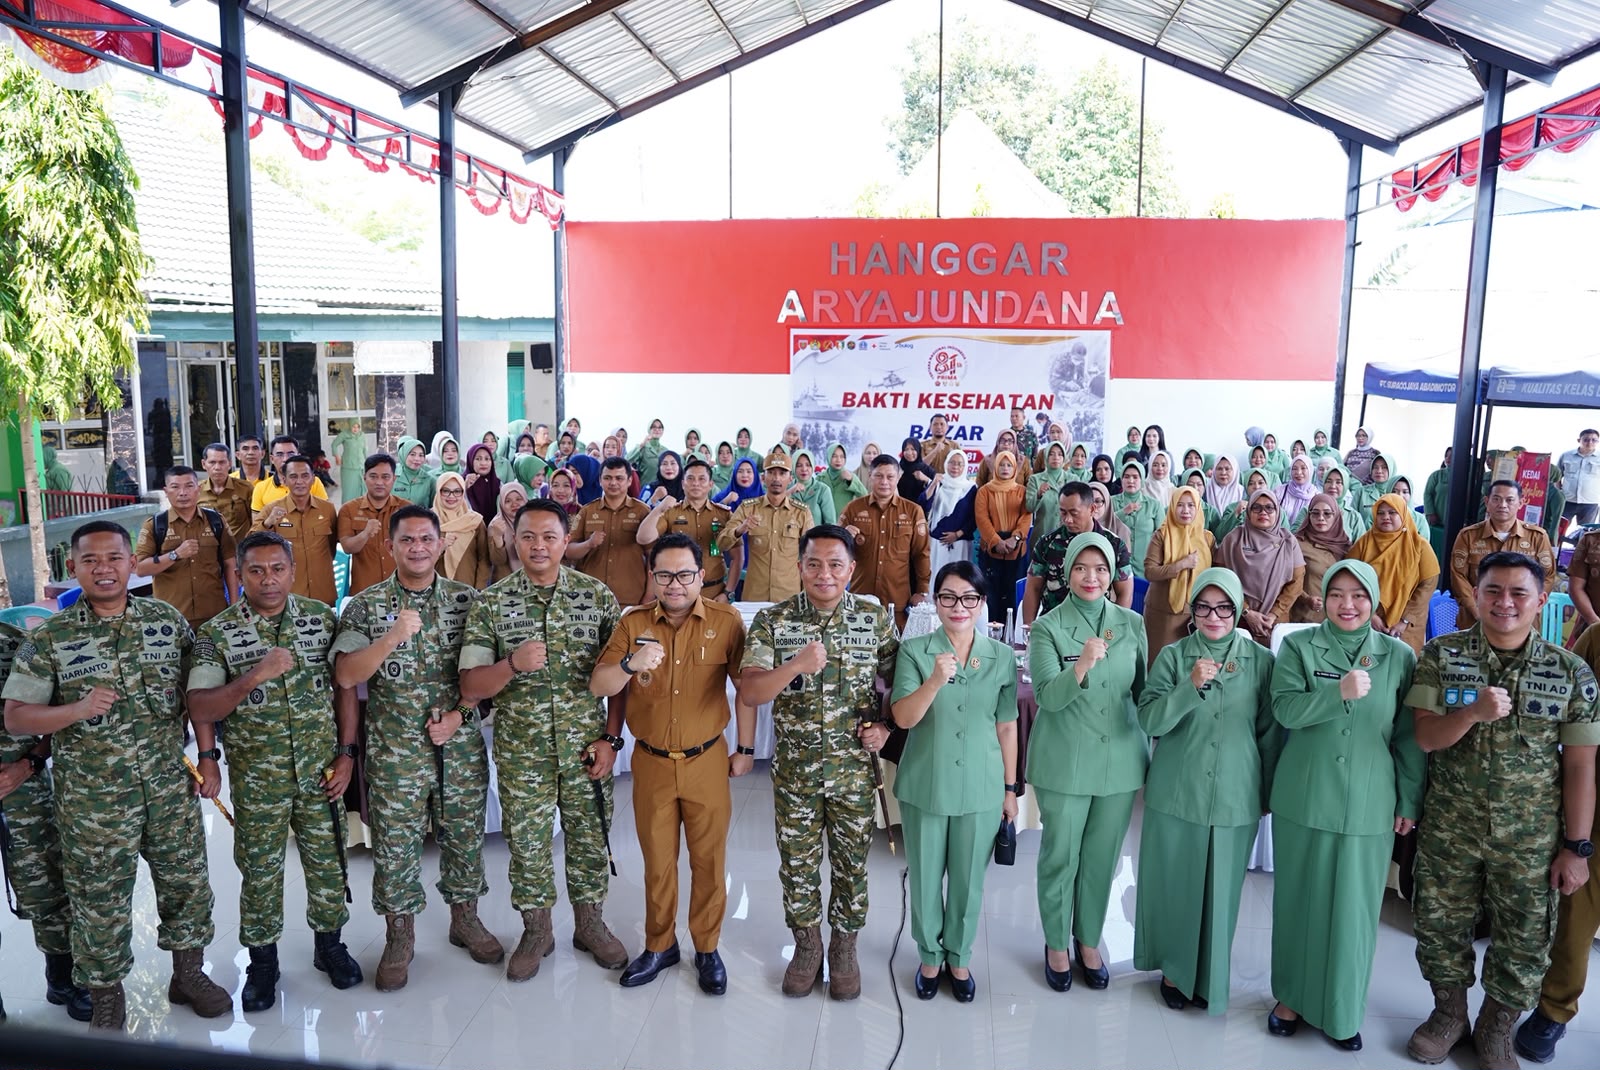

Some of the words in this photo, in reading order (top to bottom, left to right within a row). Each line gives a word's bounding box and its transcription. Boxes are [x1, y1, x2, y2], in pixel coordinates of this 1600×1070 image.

[830, 242, 1069, 276] HANGGAR
[1521, 382, 1562, 394] KUALITAS
[1563, 383, 1595, 397] KELAS
[841, 392, 910, 409] BAKTI
[917, 393, 1055, 411] KESEHATAN
[945, 413, 960, 422] AN
[1522, 469, 1541, 480] KEDAI
[443, 619, 459, 627] TNI
[569, 614, 584, 622] TNI
[588, 614, 598, 623] AD
[297, 639, 315, 649] TNI
[318, 638, 329, 646] AD
[775, 637, 808, 647] ROBINSON
[843, 637, 862, 646] TNI
[865, 637, 878, 646] AD
[142, 652, 161, 662] TNI
[164, 651, 179, 660] AD
[61, 661, 109, 682] HARIANTO
[1441, 673, 1485, 684] WINDRA
[1525, 681, 1547, 692] TNI
[1549, 685, 1568, 695] AD
